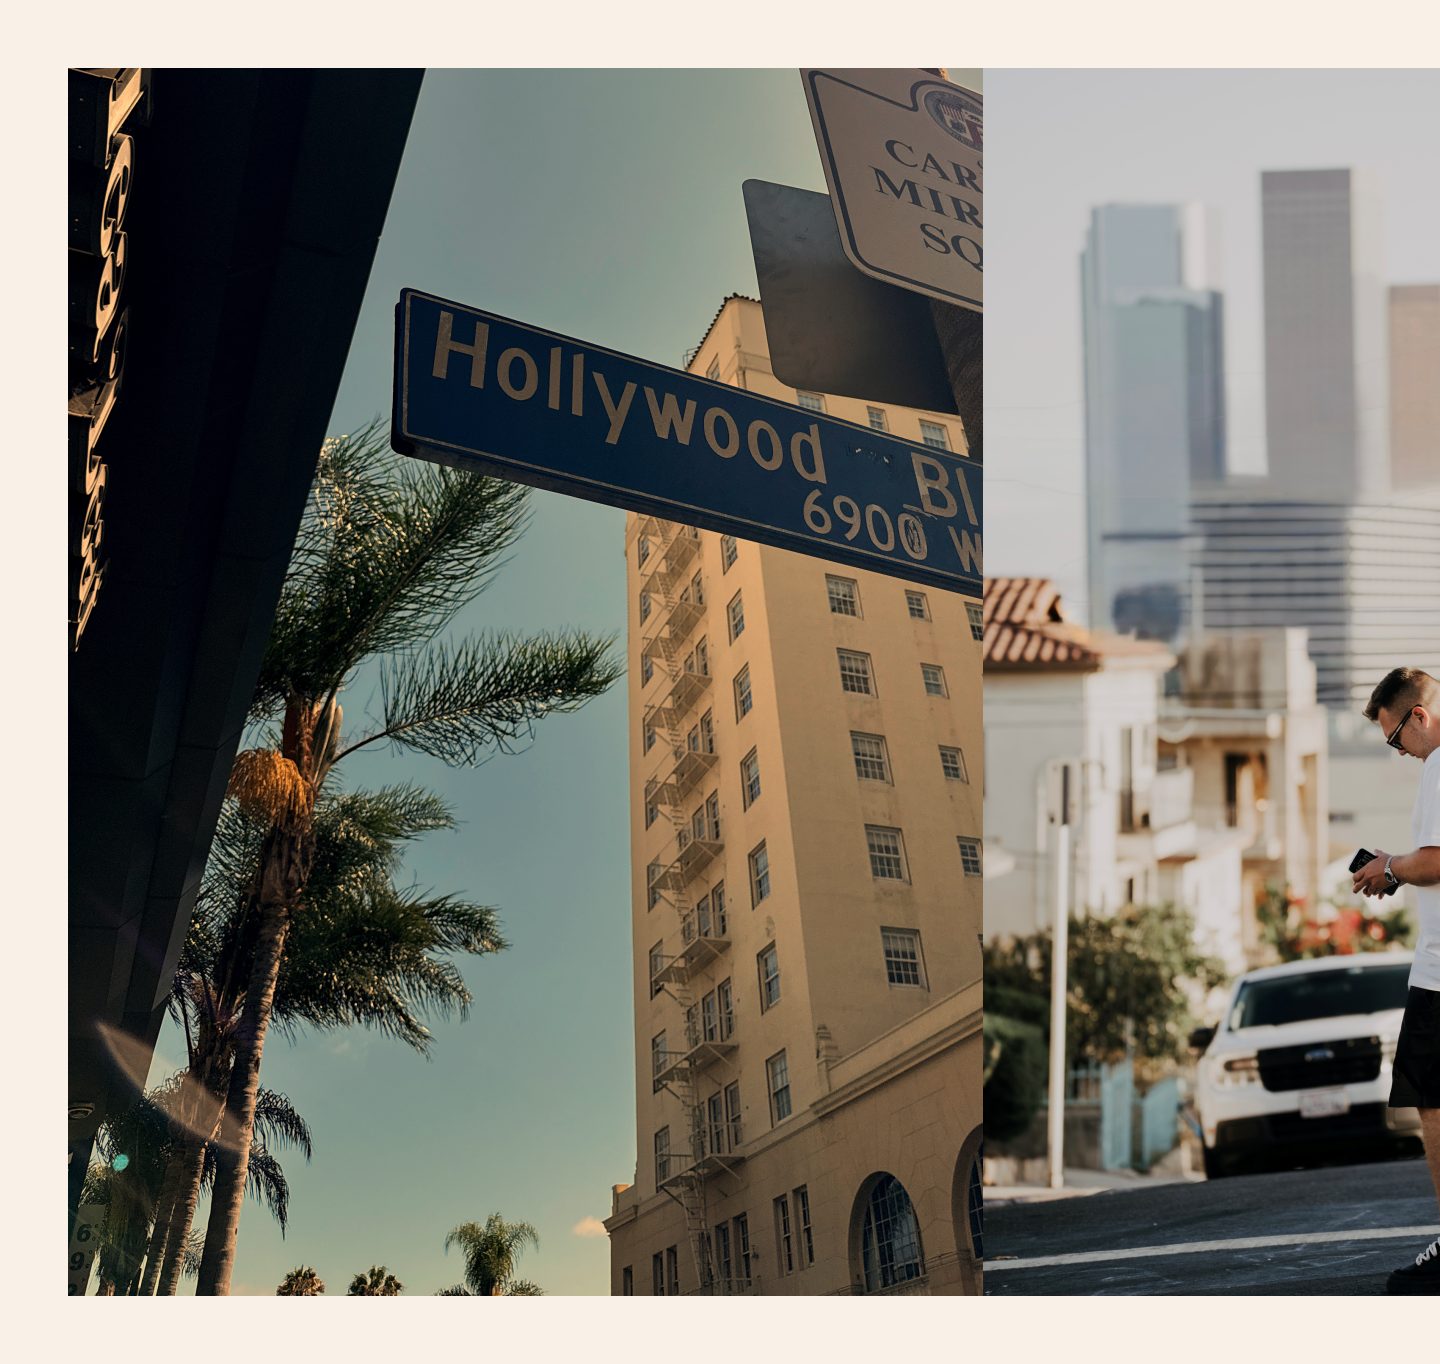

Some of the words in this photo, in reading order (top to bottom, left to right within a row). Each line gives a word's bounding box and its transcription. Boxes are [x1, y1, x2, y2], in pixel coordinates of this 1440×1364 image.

[885, 139, 983, 194] CAR
[432, 310, 828, 485] Hollywood
[803, 489, 928, 561] 6900
